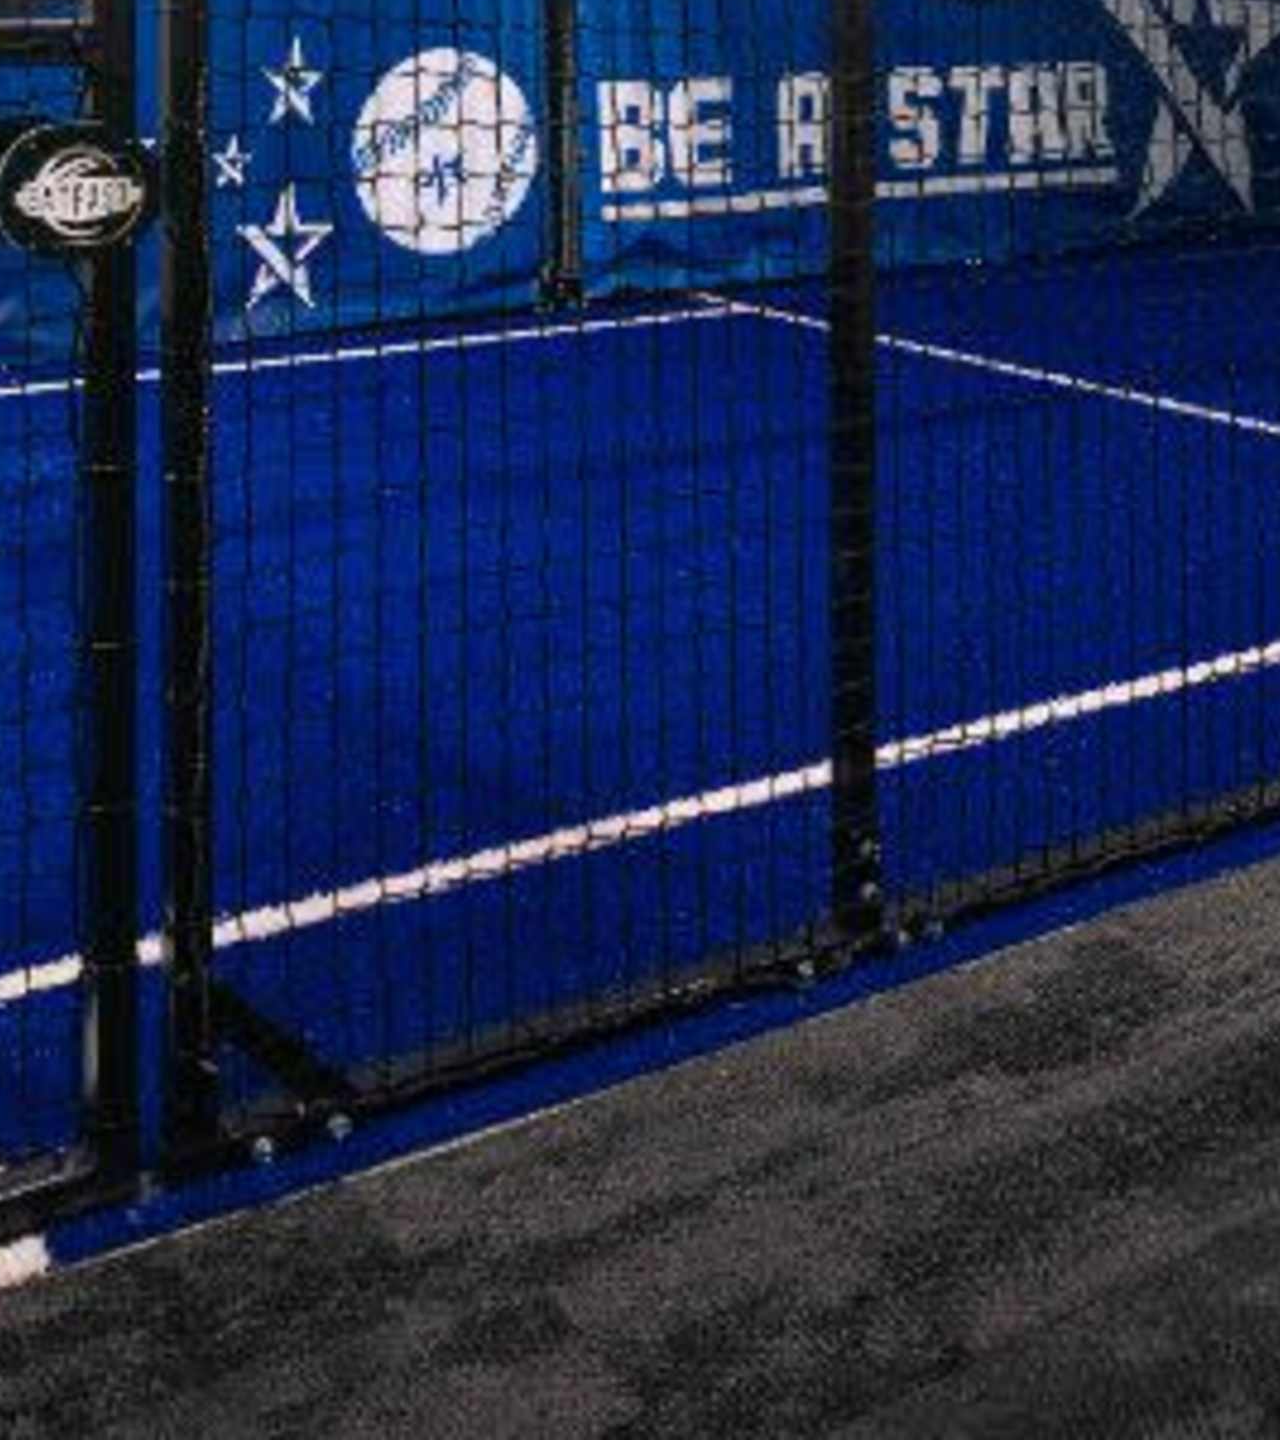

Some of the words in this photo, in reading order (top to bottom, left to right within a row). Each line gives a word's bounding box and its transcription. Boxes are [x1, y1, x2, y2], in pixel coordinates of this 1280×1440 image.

[597, 77, 732, 193] BE
[776, 72, 832, 177] A
[887, 63, 1115, 170] STAR
